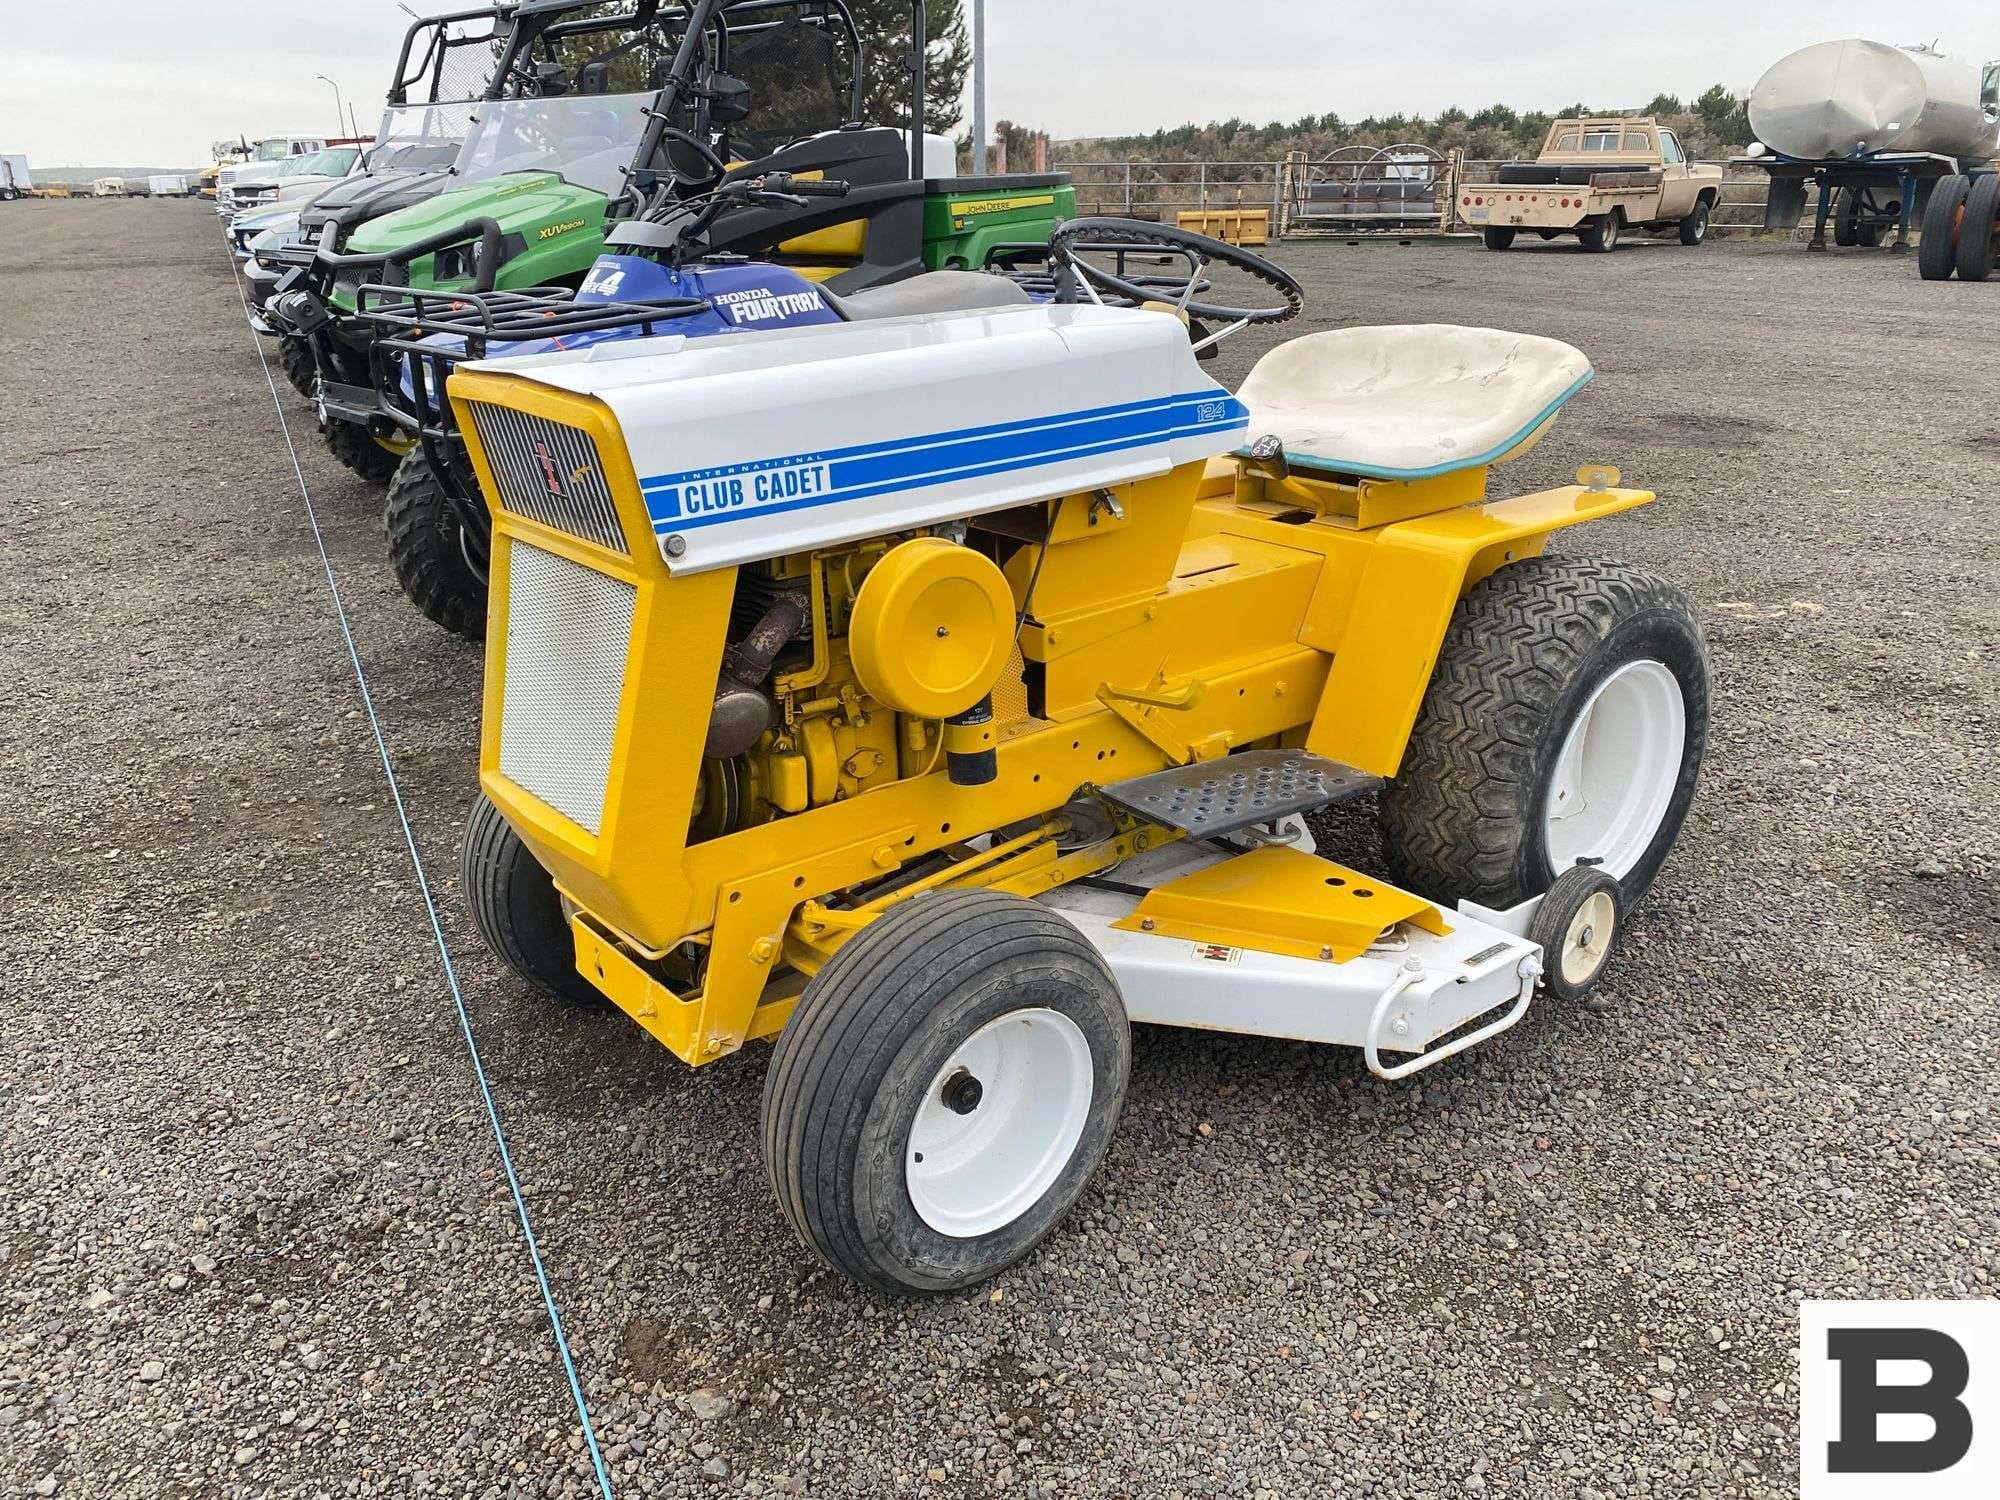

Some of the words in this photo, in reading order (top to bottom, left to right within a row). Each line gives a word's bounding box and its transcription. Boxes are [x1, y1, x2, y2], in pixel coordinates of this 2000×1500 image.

[966, 204, 987, 214] JOHN
[987, 201, 1011, 212] DEERE
[714, 288, 774, 306] HONDA
[730, 291, 825, 324] FOURTRAX
[1197, 401, 1225, 422] 124
[682, 455, 823, 481] INTERNATIONAL
[684, 479, 744, 514] CLUB
[754, 465, 824, 502] CADET
